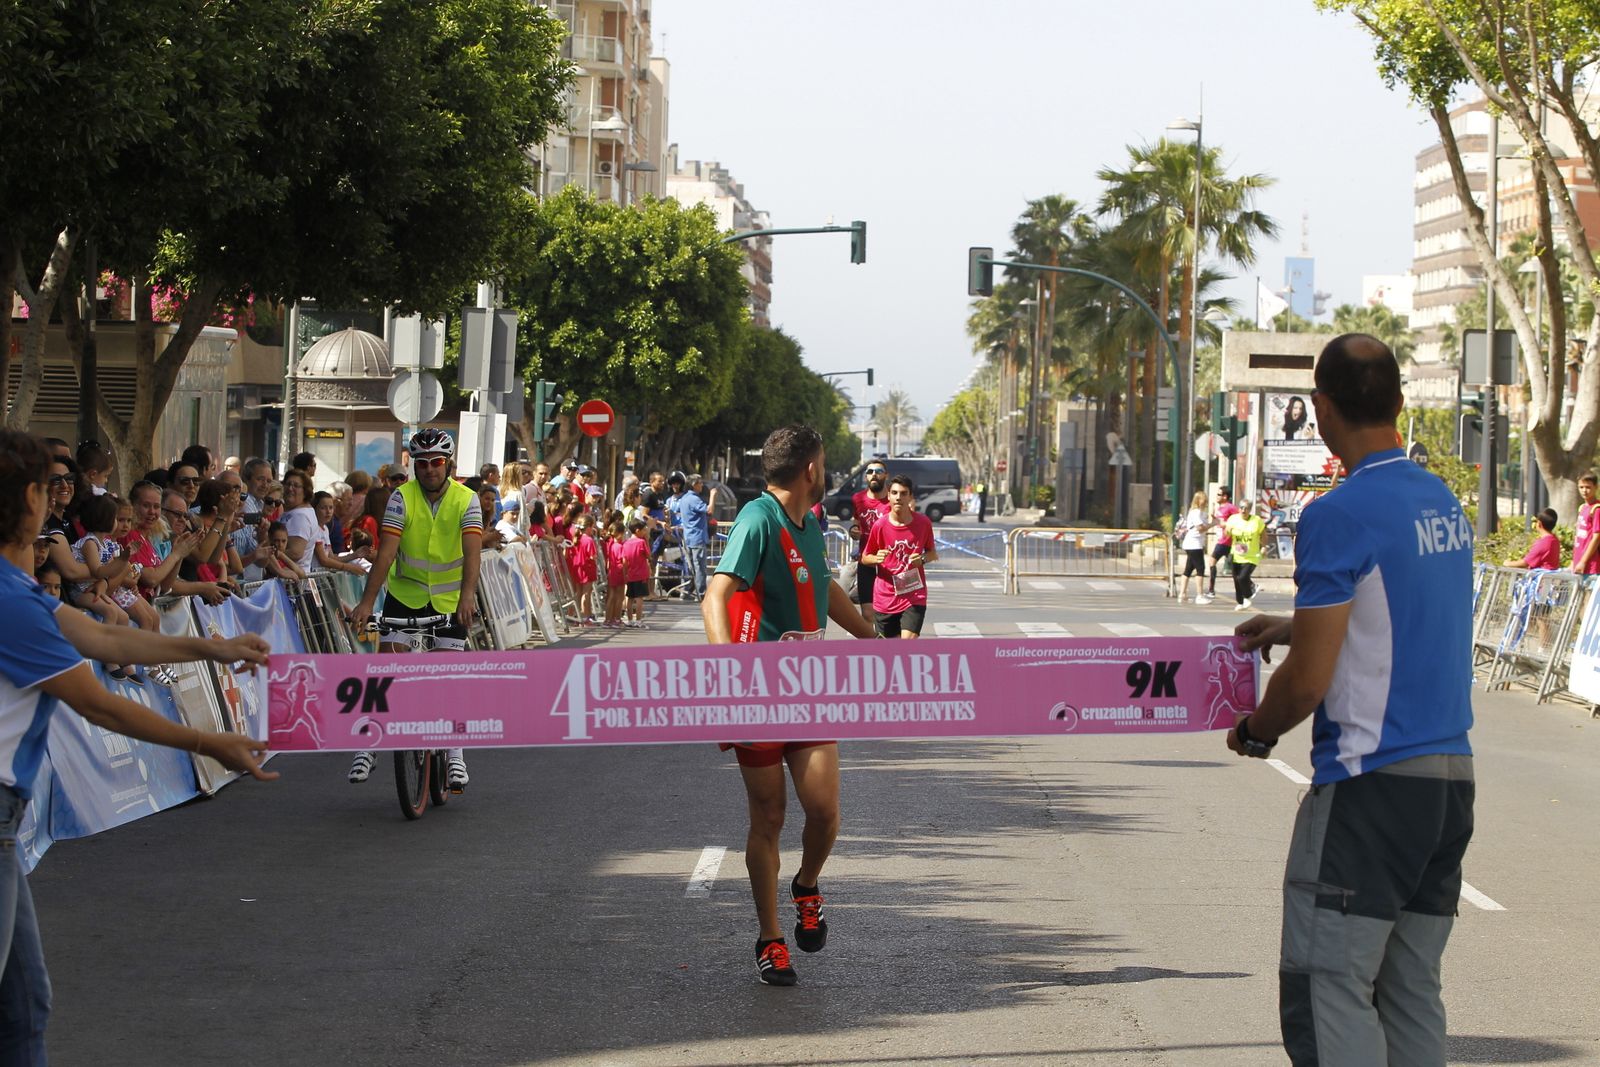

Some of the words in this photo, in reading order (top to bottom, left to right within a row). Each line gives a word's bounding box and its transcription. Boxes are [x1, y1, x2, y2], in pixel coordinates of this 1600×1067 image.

[1414, 507, 1471, 556] NEXA
[995, 646, 1150, 660] lasallecorreparaayudar.com
[366, 661, 526, 677] lasallecorreparaayudar.com
[1126, 660, 1182, 698] 9K
[336, 677, 395, 714] 9K
[550, 653, 592, 741] 4
[589, 656, 770, 702] CARRERA
[778, 653, 976, 697] SOLIDARIA
[593, 707, 632, 729] POR
[634, 706, 669, 728] LAS
[672, 703, 811, 727] ENFERMEDADES
[815, 702, 860, 724] POCO
[863, 701, 976, 723] FRECUENTES
[1081, 704, 1188, 720] cruzandolameta
[386, 718, 503, 736] cruzandolameta
